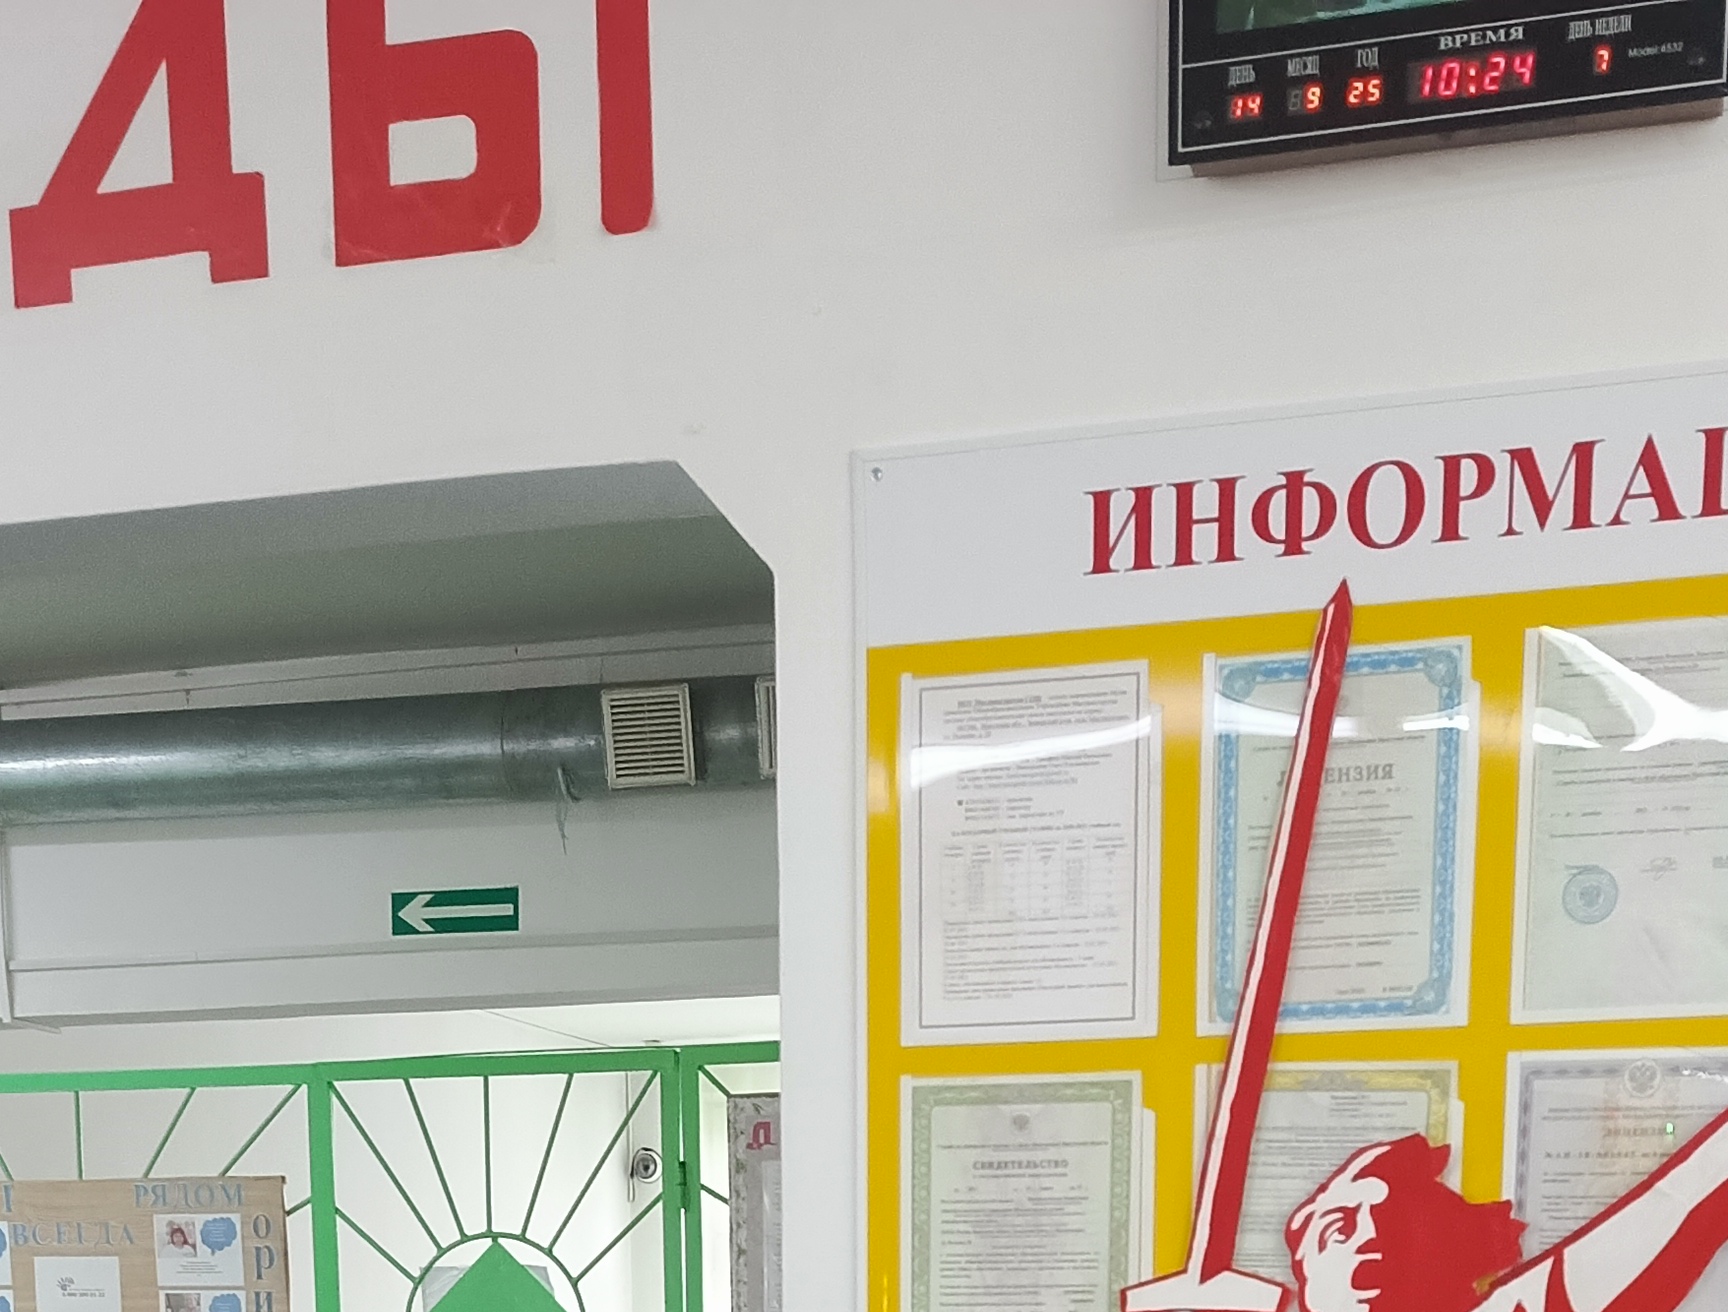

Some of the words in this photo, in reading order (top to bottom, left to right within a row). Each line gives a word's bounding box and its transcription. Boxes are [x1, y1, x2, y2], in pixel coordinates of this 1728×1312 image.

[1438, 26, 1525, 50] ВРЕМЯ
[1287, 55, 1320, 78] МЕСЯЦ
[1356, 47, 1380, 70] ГОД
[1595, 47, 1611, 72] 7
[1227, 65, 1256, 87] ДЕНЬ
[1420, 53, 1536, 98] 10:24
[1304, 84, 1322, 111] 9
[1347, 77, 1383, 106] 25
[1231, 94, 1262, 118] 14
[133, 1183, 244, 1209] РЯДОМ
[11, 1222, 135, 1248] ВСЕГДА
